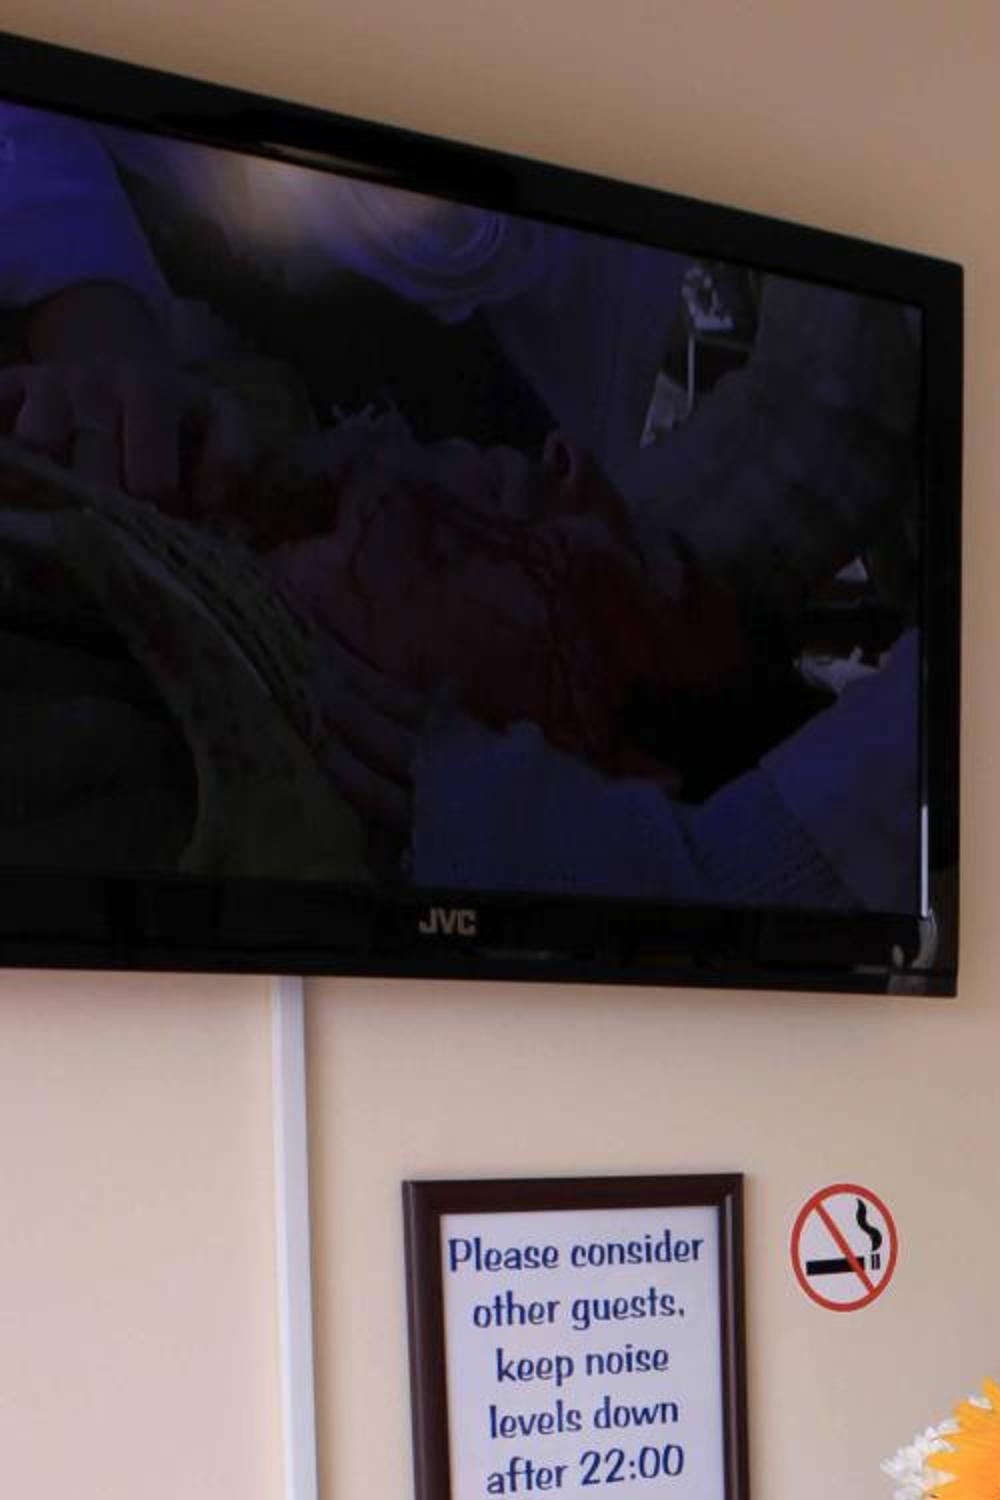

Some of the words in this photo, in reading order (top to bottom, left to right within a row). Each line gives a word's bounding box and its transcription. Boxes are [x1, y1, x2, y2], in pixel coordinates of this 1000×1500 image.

[419, 907, 476, 935] JVC
[448, 1237, 559, 1272] Please
[571, 1228, 704, 1268] consider
[473, 1290, 560, 1328] other
[496, 1348, 573, 1387] keep
[586, 1344, 668, 1376] noise
[489, 1400, 582, 1439] levels
[593, 1396, 678, 1430] down
[487, 1457, 567, 1495] after
[580, 1444, 684, 1486] 22:00
